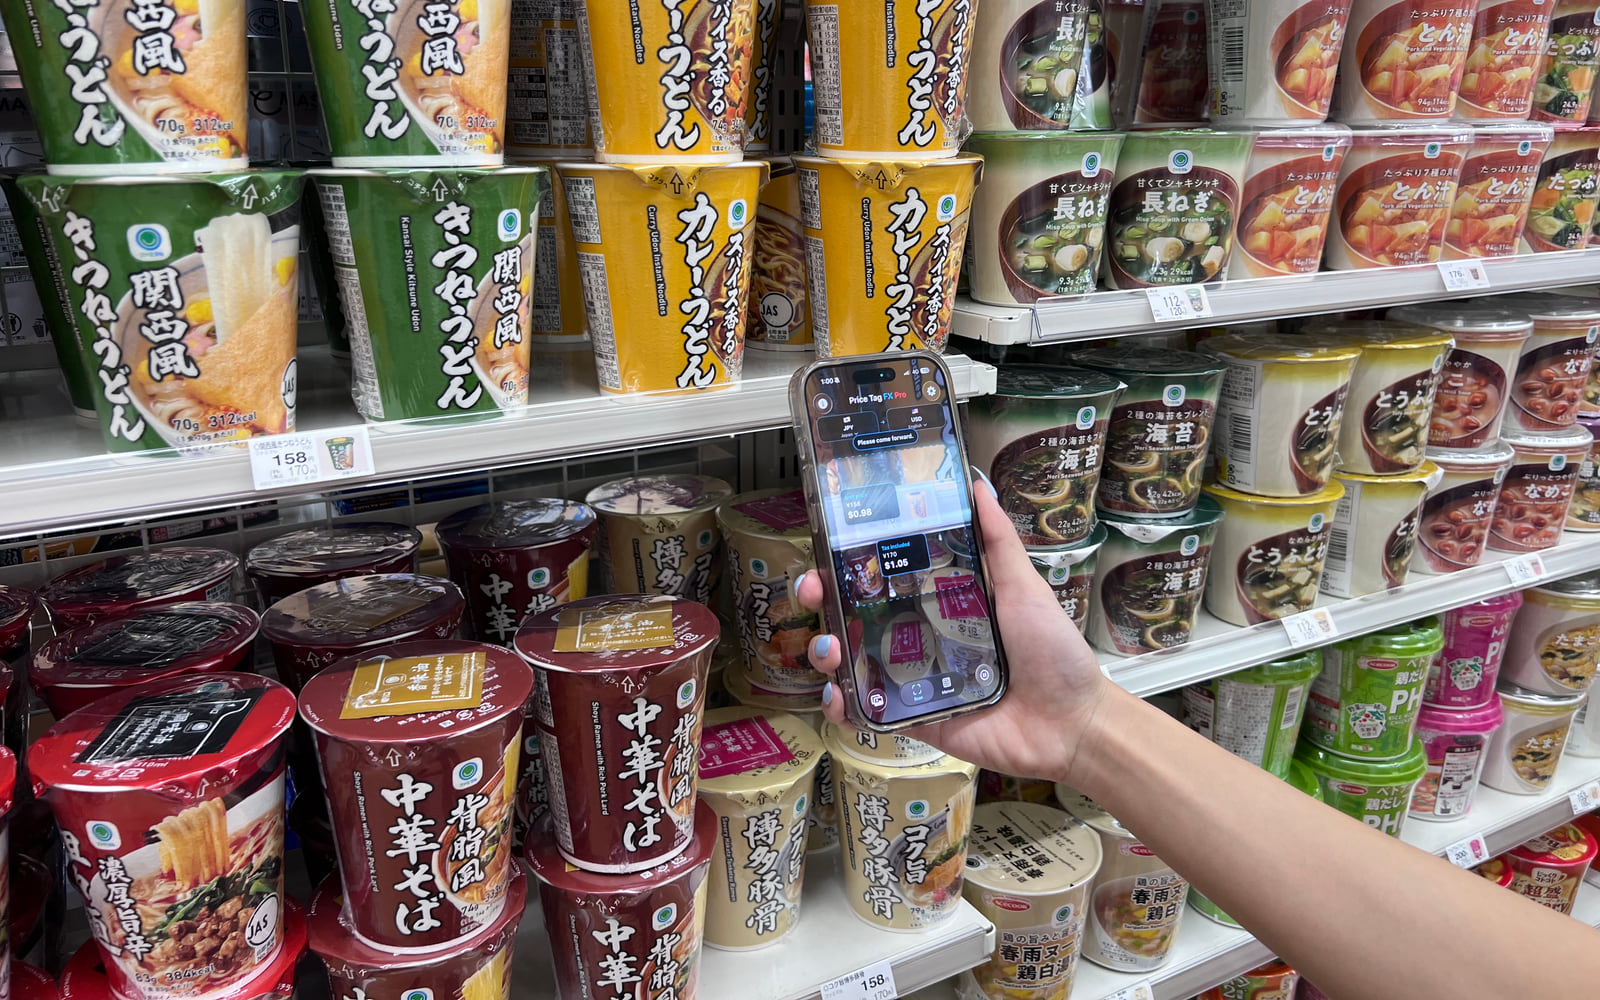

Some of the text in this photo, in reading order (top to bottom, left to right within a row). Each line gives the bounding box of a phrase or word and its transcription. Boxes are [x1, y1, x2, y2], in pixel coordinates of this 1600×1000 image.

[1417, 22, 1470, 43] とん汁
[633, 28, 646, 65] Noodles
[887, 34, 896, 68] Noodles
[53, 0, 126, 148] うどん
[158, 118, 235, 134] 70g 312kcal
[1136, 178, 1221, 188] 甘くてシャキシャキ
[1392, 180, 1450, 201] とん汁
[1053, 194, 1108, 221] 長ねぎ
[1141, 190, 1214, 214] 長ねぎ
[647, 205, 667, 316] Curry Udon Instant Noodles
[861, 197, 874, 298] Curry Udon Instant Noodles
[401, 216, 421, 332] Kansai Style Kitsune Udon
[923, 225, 951, 336] スパイス香る
[1058, 276, 1074, 287] 9.3g
[1170, 267, 1194, 276] 29kcal
[492, 246, 522, 350] 関西風
[676, 193, 718, 388] カレーうどん
[721, 232, 744, 354] スパイス香る
[1163, 295, 1180, 308] 112
[430, 201, 484, 410] きつねうどん
[760, 304, 778, 317] JAS
[63, 211, 147, 442] きつねうどん
[127, 266, 200, 382] 関西風
[820, 378, 834, 386] 1:00
[848, 391, 907, 405] Price Tag FX Pro
[173, 411, 257, 431] 70g 312kcal
[843, 424, 854, 433] JPY
[1145, 421, 1195, 444] 海苔
[857, 433, 914, 447] Please come forward.
[272, 451, 308, 467] 158
[1057, 443, 1099, 471] 海苔
[1524, 483, 1572, 499] なめこ
[848, 508, 872, 520] $0.98
[881, 541, 911, 552] Tax included
[884, 558, 909, 571] $1.05
[1163, 567, 1203, 591] 海苔
[750, 582, 774, 643] コク旨
[894, 739, 911, 750] 79g
[591, 701, 609, 816] Shoyu Ramen with Rich Pork Lard
[669, 711, 697, 808] 背脂風
[618, 696, 665, 853] 中華そば
[353, 771, 380, 893] Shoyu Ramen with Rich Pork Lard
[445, 792, 491, 894] 背脂風
[379, 773, 448, 936] 中華そば
[788, 819, 806, 885] コク旨
[855, 793, 905, 921] 博多豚骨
[902, 823, 932, 886] コク旨
[742, 809, 786, 936] 博多豚骨
[98, 856, 153, 963] 濃厚旨辛
[248, 914, 269, 941] JAS
[165, 964, 217, 982] 384kcal
[860, 974, 885, 991] 158
